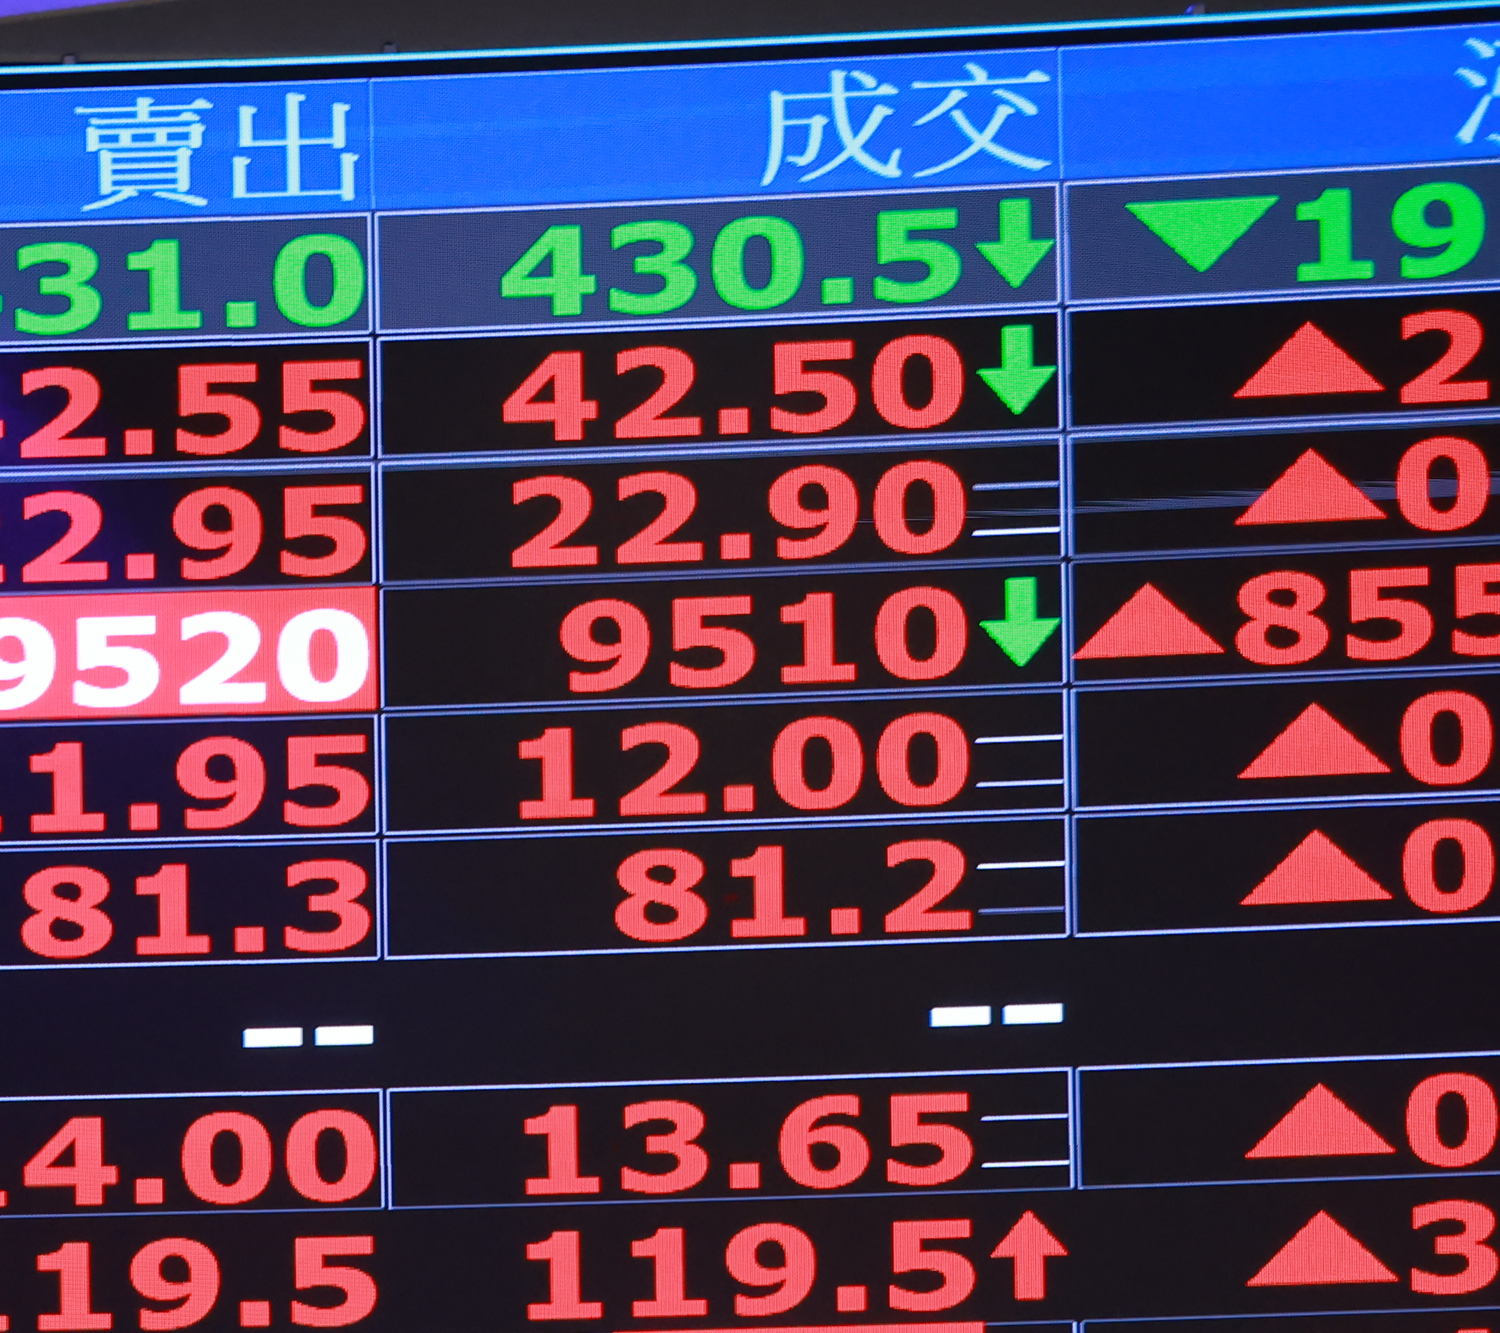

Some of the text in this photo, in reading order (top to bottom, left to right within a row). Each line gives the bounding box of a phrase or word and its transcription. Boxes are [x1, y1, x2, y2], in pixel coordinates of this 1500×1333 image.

[75, 92, 359, 212] 賣出
[762, 65, 1052, 187] 成交
[500, 208, 961, 316] 430.5
[559, 586, 968, 693] 9510
[526, 1218, 977, 1320] 119.5
